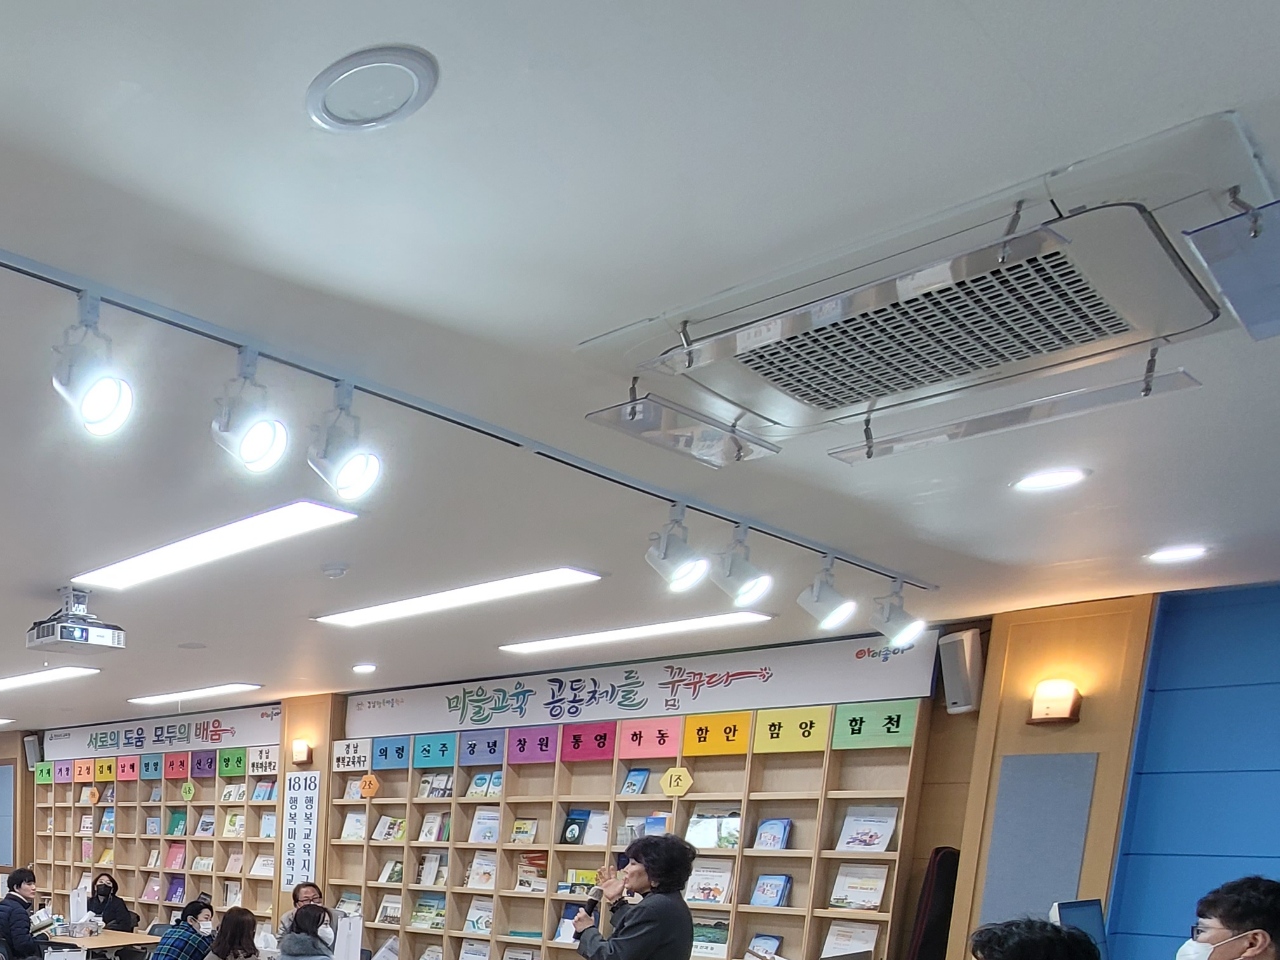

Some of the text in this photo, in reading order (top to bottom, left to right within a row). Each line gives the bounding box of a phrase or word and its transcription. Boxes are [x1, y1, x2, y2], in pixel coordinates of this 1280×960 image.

[446, 664, 770, 724] 마을교육 공동체를 꿈꾸다
[87, 719, 234, 751] 서로의 도움 모두의 배움
[571, 732, 607, 750] 통영
[344, 743, 359, 755] 경남
[378, 745, 405, 760] 의령
[516, 736, 549, 753] 창원
[223, 756, 244, 768] 양산
[258, 749, 270, 760] 경남
[288, 776, 301, 792] 18
[303, 775, 317, 791] 18
[285, 796, 298, 886] 행복마을학교
